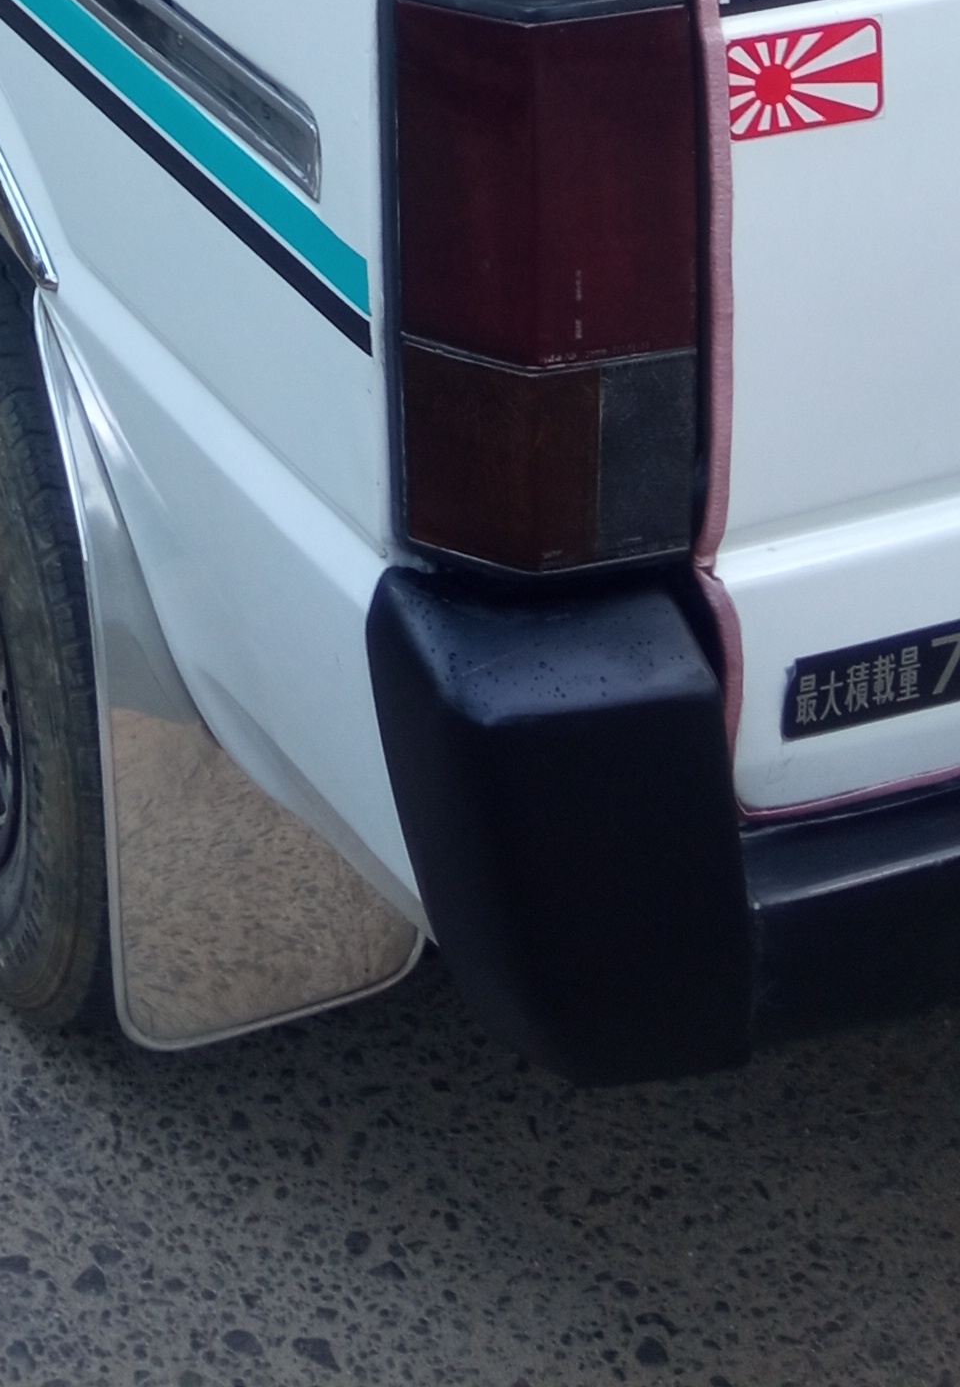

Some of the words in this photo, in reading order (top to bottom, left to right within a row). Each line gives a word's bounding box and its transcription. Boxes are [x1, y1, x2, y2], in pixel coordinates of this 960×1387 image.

[796, 645, 921, 725] 最大積載量
